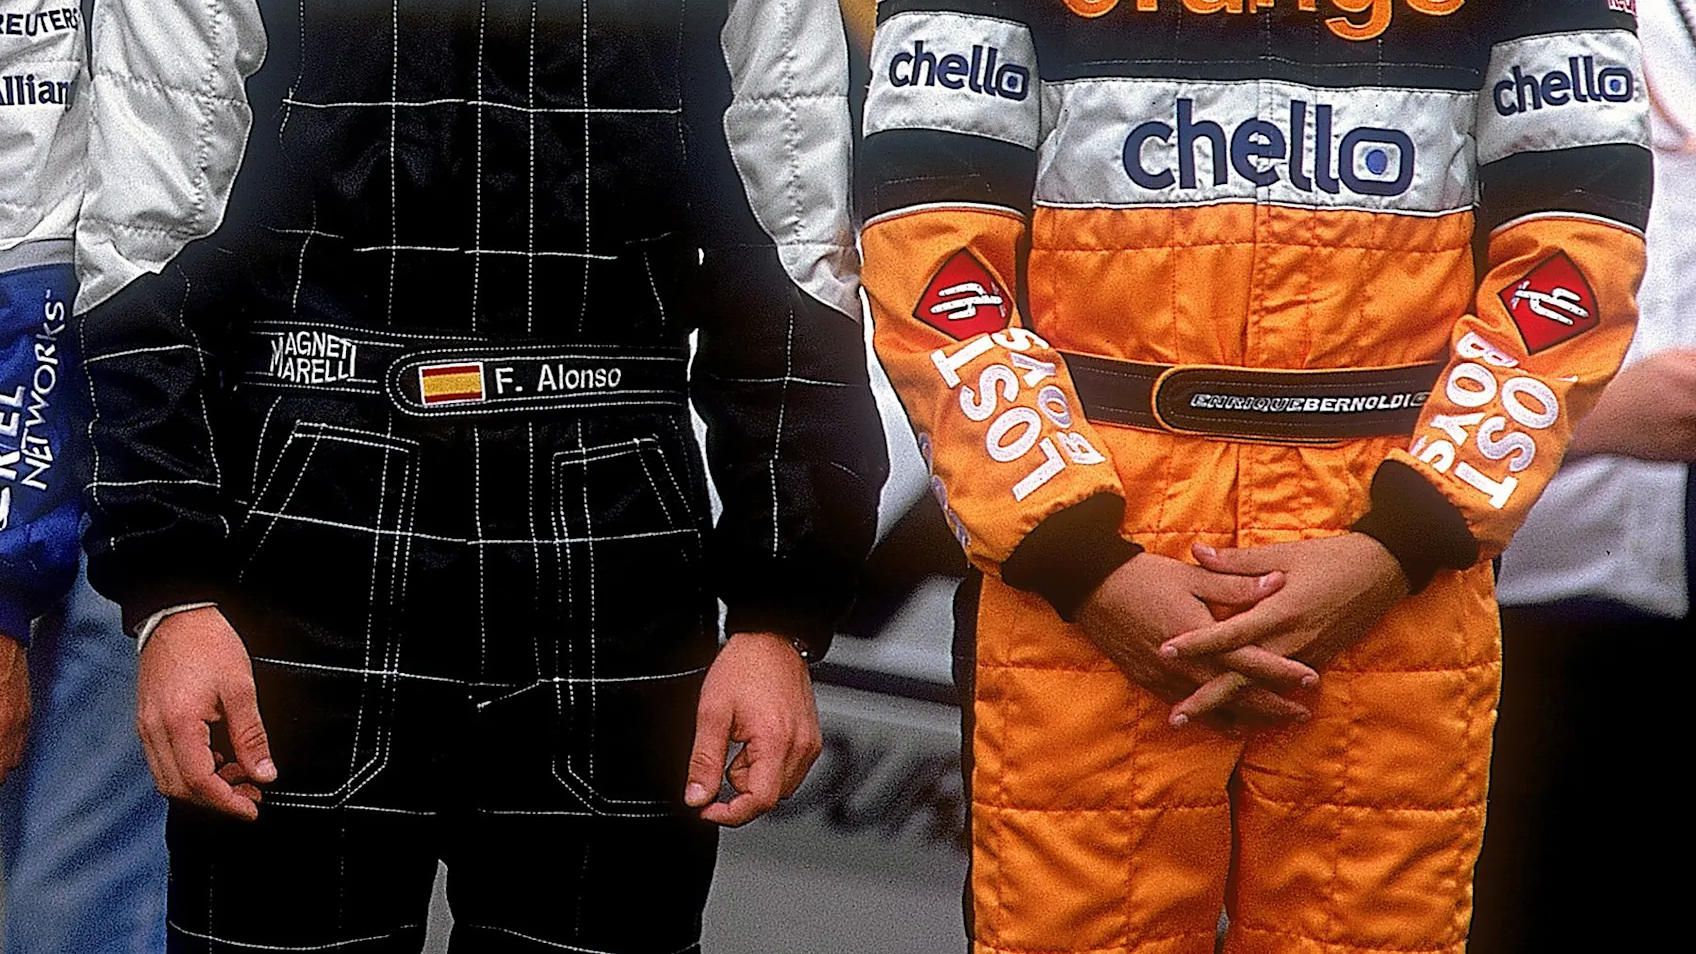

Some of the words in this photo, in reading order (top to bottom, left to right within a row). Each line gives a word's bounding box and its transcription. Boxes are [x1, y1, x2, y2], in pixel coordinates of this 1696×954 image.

[888, 39, 1031, 102] chello
[1493, 55, 1635, 117] chello
[1121, 97, 1416, 197] chello
[270, 331, 356, 361] MAGNETI
[494, 366, 524, 395] F.
[537, 363, 623, 393] Alonso
[20, 299, 66, 491] NETWORKS
[930, 332, 1067, 503] LOST
[991, 327, 1107, 465] BOYS
